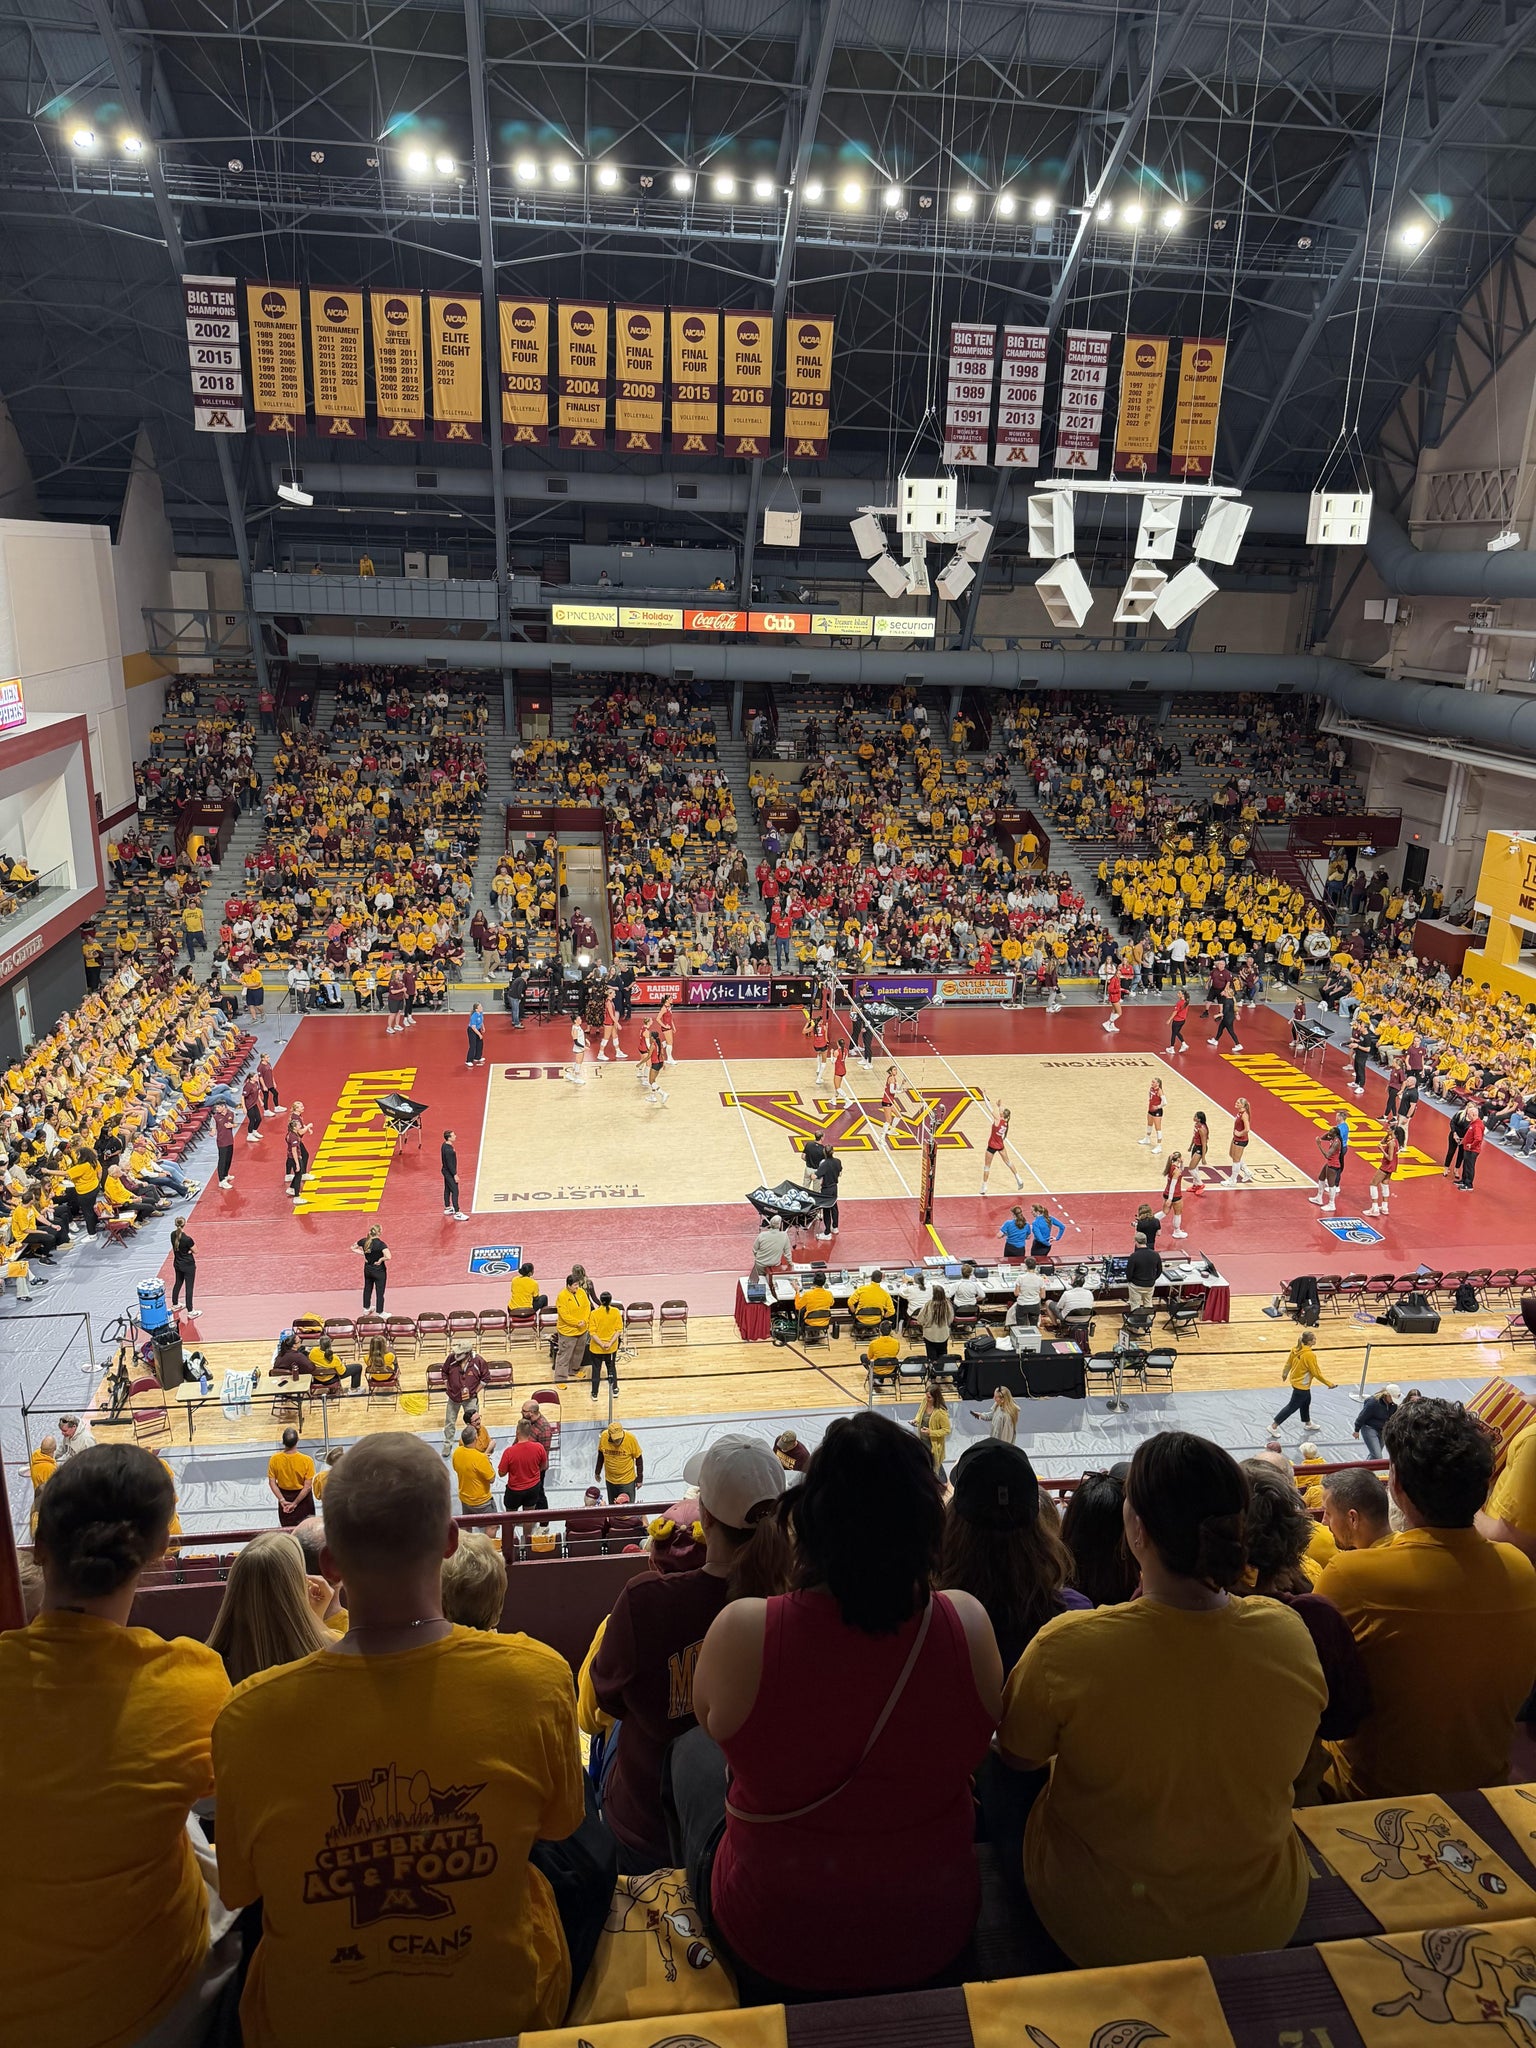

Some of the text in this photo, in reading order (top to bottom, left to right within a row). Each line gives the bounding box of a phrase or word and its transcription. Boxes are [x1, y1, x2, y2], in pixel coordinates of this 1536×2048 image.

[188, 291, 233, 305] BIG TEN
[188, 305, 235, 316] CHAMPIONS
[264, 304, 286, 313] NCAA
[327, 309, 348, 317] NCAA
[387, 311, 409, 319] NCAA
[446, 315, 467, 323] NCAA
[254, 321, 297, 330] TOURNAMENT
[515, 319, 535, 327] NCAA
[573, 323, 594, 331] NCAA
[195, 323, 230, 338] 2002
[316, 325, 359, 334] TOURNAMENT
[387, 330, 408, 338] SWEET
[685, 328, 704, 336] NCAA
[443, 332, 468, 343] ELITE
[954, 333, 993, 346] BIG TEN
[1007, 336, 1046, 349] BIG TEN
[511, 339, 539, 350] FINAL
[570, 343, 597, 354] FINAL
[1069, 341, 1107, 354] BIG TEN
[442, 345, 470, 356] EIGHT
[626, 347, 654, 358] FINAL
[682, 349, 708, 360] FINAL
[953, 346, 993, 355] CHAMPIONS
[1006, 350, 1045, 359] CHAMPIONS
[198, 350, 232, 364] 2015
[401, 358, 417, 366] 2013
[512, 352, 538, 363] FOUR
[571, 355, 595, 366] FOUR
[736, 353, 762, 363] FINAL
[796, 356, 822, 366] FINAL
[1068, 354, 1106, 363] CHAMPIONS
[627, 359, 652, 370] FOUR
[683, 362, 707, 372] FOUR
[736, 365, 760, 375] FOUR
[957, 362, 986, 375] 1988
[797, 368, 820, 378] FOUR
[1010, 365, 1038, 378] 1998
[1071, 369, 1099, 382] 2014
[200, 376, 234, 390] 2018
[508, 376, 541, 391] 2003
[566, 380, 599, 394] 2004
[381, 392, 398, 400] 2010
[623, 383, 655, 398] 2009
[678, 386, 710, 400] 2015
[732, 389, 764, 403] 2016
[956, 385, 984, 399] 1989
[1007, 388, 1037, 401] 2006
[792, 392, 823, 406] 2019
[1069, 392, 1097, 406] 2016
[566, 403, 600, 412] FINALIST
[954, 410, 982, 423] 1991
[1005, 412, 1035, 425] 2013
[1066, 416, 1094, 429] 2021
[643, 612, 673, 621] Holiday
[692, 613, 738, 629] Coca-Cola
[764, 615, 794, 631] Cub
[890, 622, 933, 630] securian
[690, 985, 768, 1000] Mystic LAKE
[877, 987, 902, 995] planet
[1220, 1052, 1445, 1181] MINNESOTA
[293, 1067, 417, 1214] MINNESOTA
[494, 1189, 645, 1202] TRUSTONE
[319, 1828, 480, 1869] CELEBRATE
[307, 1846, 495, 1900] AG & FOOD
[389, 1925, 472, 1955] CFANS
